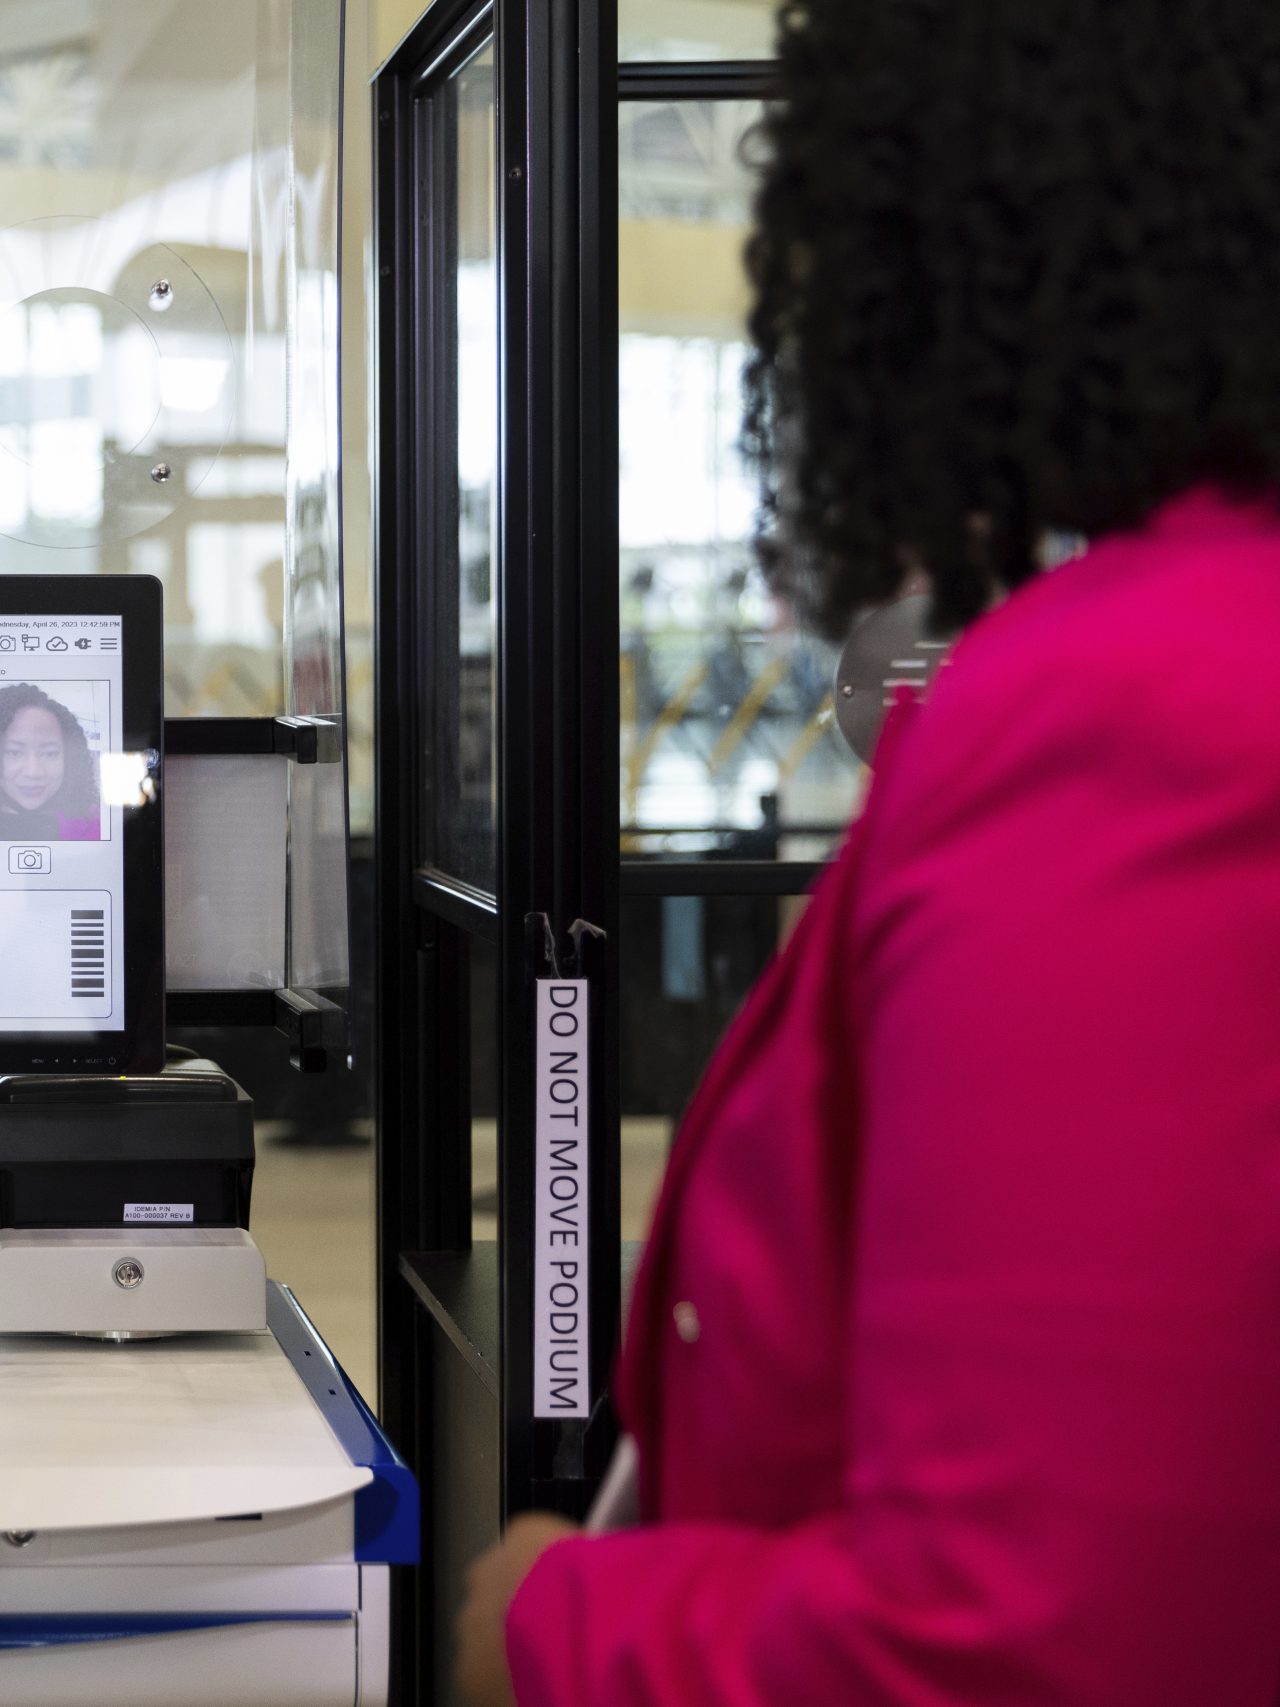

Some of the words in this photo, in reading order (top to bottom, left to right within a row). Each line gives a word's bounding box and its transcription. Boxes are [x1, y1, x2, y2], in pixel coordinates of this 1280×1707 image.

[549, 986, 578, 1037] DO
[549, 1052, 578, 1127] NOT
[549, 1140, 578, 1247] MOVE
[549, 1261, 578, 1409] PODIUM
